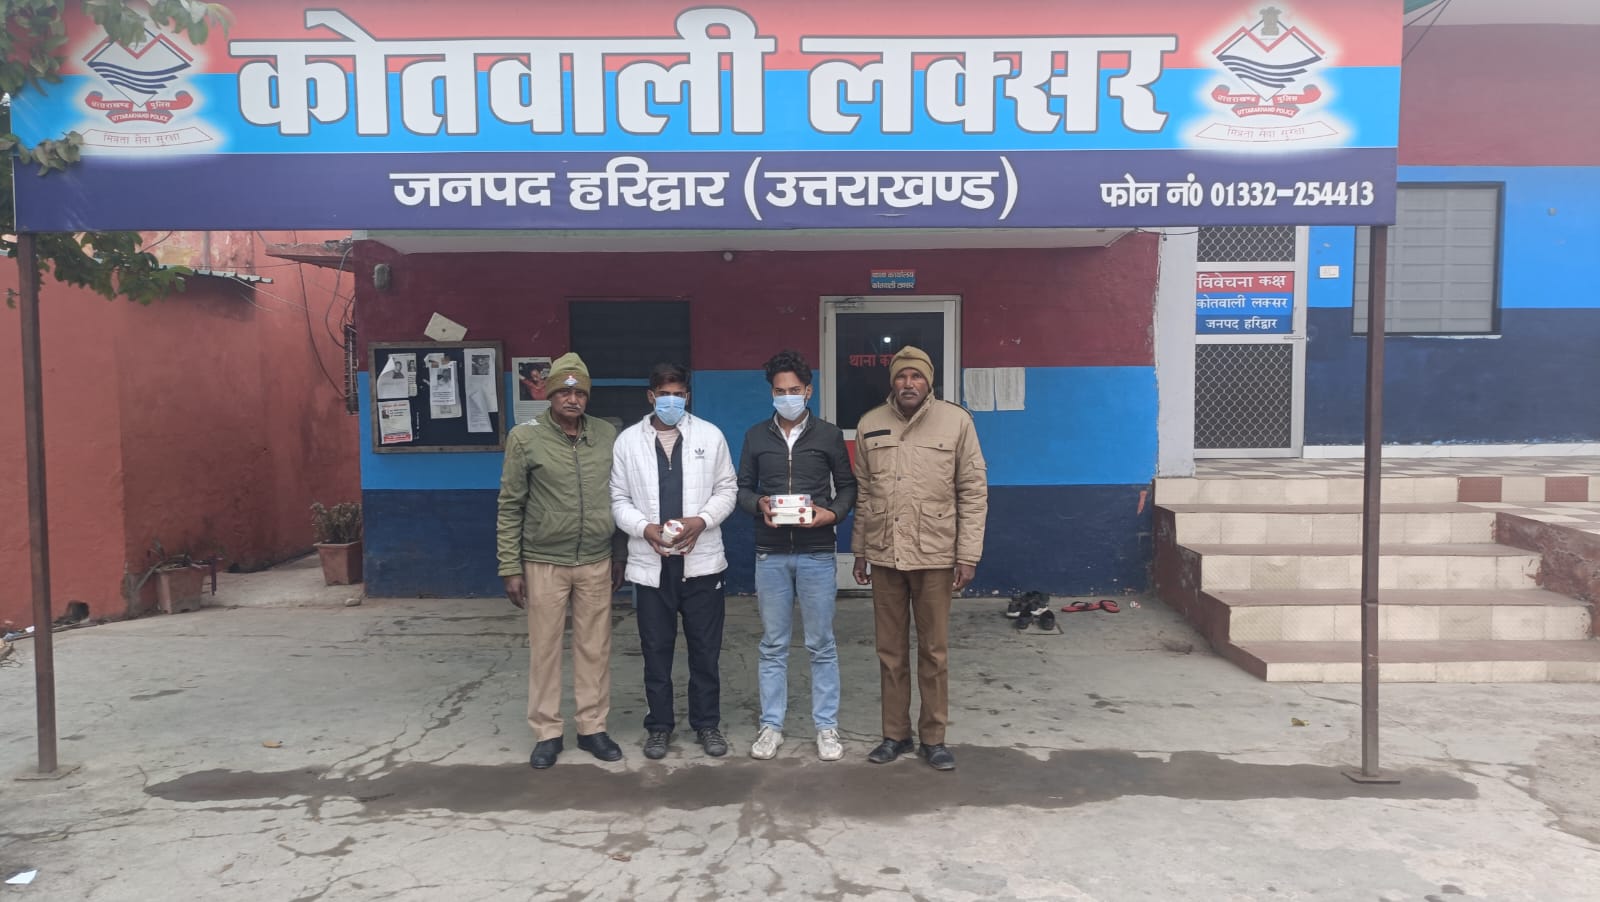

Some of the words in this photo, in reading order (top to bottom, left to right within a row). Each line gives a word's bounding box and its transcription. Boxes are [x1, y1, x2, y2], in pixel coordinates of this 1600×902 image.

[229, 7, 776, 136] कोतवाली
[800, 35, 1178, 133] लक्सर
[150, 112, 168, 121] POLICE
[1276, 107, 1294, 116] POLICE
[389, 172, 556, 207] जनपद
[567, 156, 729, 212] हरिद्वार
[744, 156, 1018, 221] (उत्तराखण्ड)
[1100, 173, 1160, 207] फोन
[1210, 181, 1375, 207] 01332-254413
[1197, 273, 1254, 288] विवेचना
[1258, 275, 1287, 288] कक्ष
[1196, 294, 1246, 309] कोतवाली
[1251, 297, 1288, 308] लक्सर
[1205, 319, 1239, 330] जनपद
[1244, 316, 1277, 330] हरिद्वार
[849, 354, 876, 368] थाना
